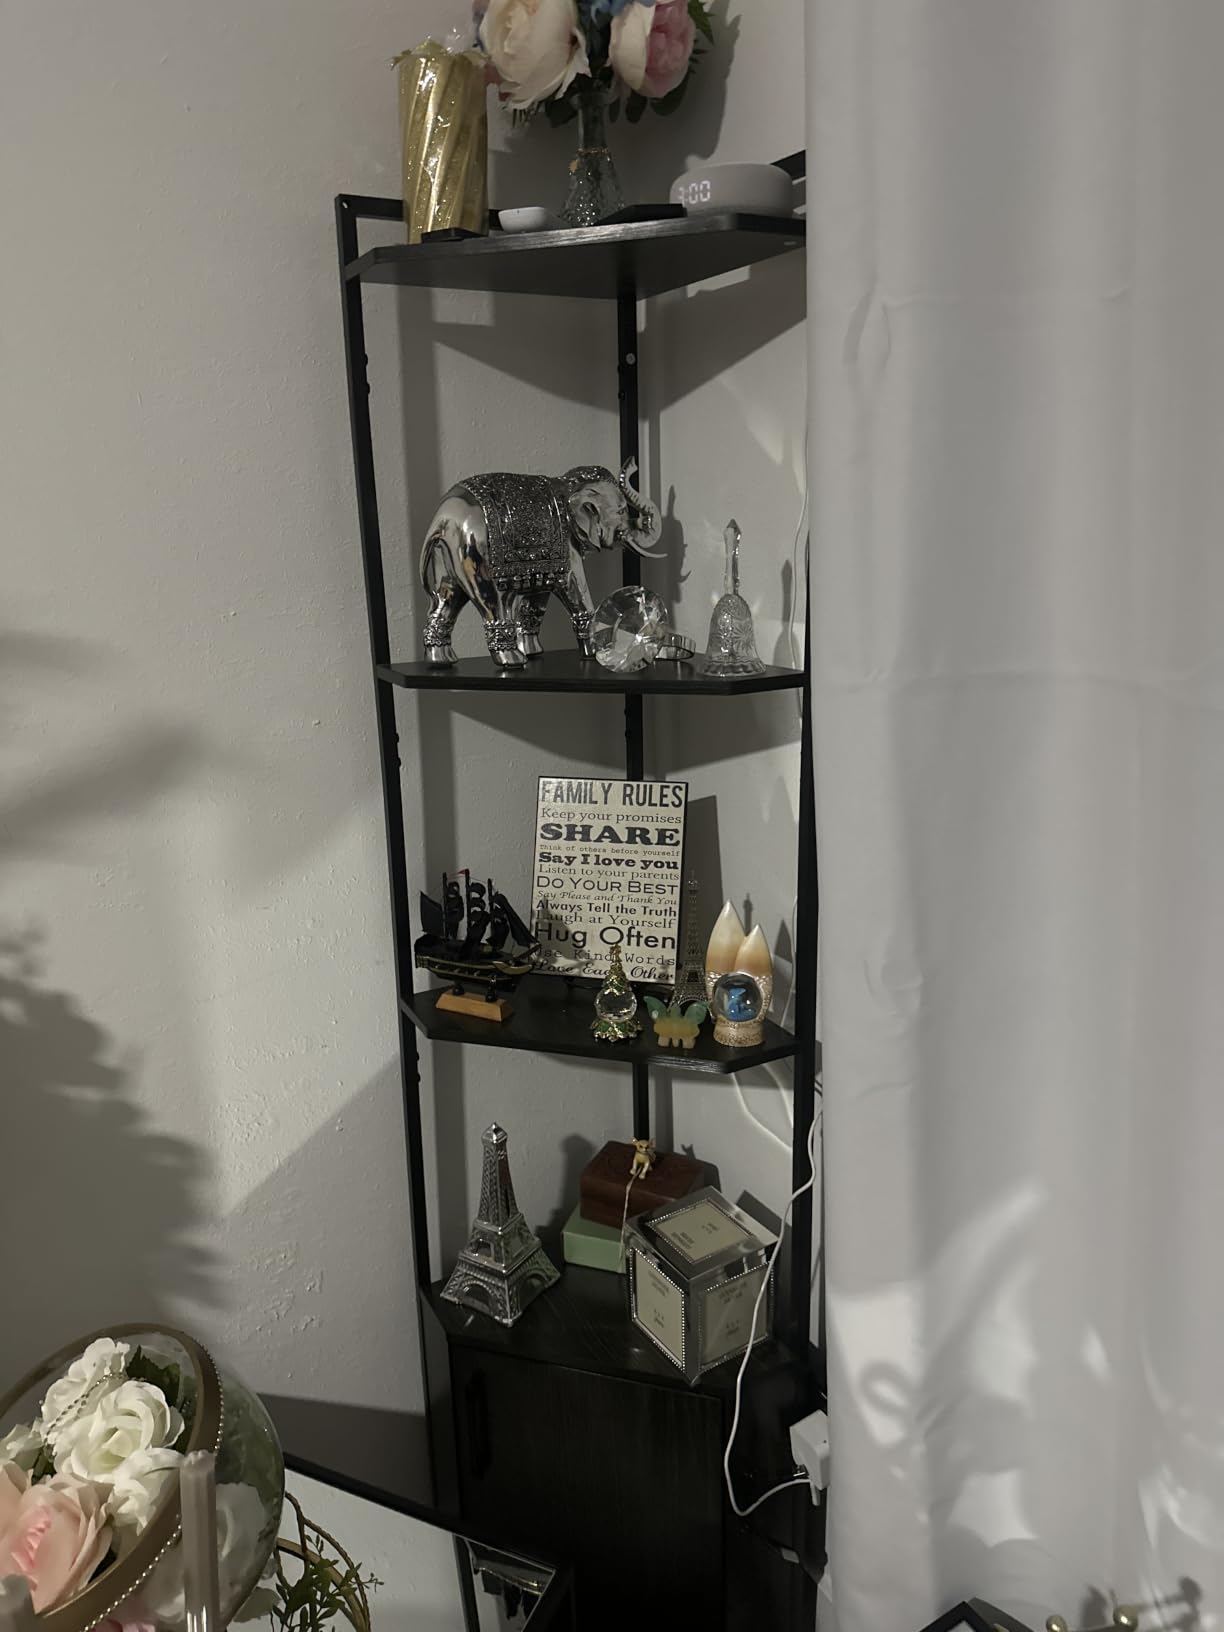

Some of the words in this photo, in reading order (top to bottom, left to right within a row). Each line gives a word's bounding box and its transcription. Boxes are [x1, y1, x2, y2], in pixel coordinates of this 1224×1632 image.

[541, 781, 612, 805] FAMILY
[622, 783, 683, 808] RULES
[541, 808, 575, 821] Keep
[580, 812, 612, 822] your
[616, 814, 682, 824] promises
[539, 822, 680, 846] SHARE
[538, 851, 577, 866] Say
[581, 853, 590, 865] I
[594, 854, 636, 867] love
[640, 859, 679, 870] you
[643, 849, 680, 857] yourself
[538, 864, 577, 875] Listen
[581, 867, 593, 876] to
[597, 869, 628, 878] your
[631, 871, 680, 881] parents
[569, 877, 622, 892] YOUR
[628, 880, 679, 895] BEST
[537, 890, 557, 900] Say
[559, 891, 592, 900] Please
[594, 893, 615, 902] and
[616, 894, 654, 904] Thank
[657, 897, 677, 905] You
[536, 900, 583, 913] Always
[587, 902, 610, 913] Tell
[615, 904, 637, 915] the
[641, 905, 677, 918] Truth
[536, 910, 583, 924] Laugh
[589, 915, 603, 924] at
[608, 914, 677, 929] Yourself
[534, 921, 587, 949] Hug
[599, 926, 676, 950] Often
[625, 952, 676, 966] Words
[582, 962, 613, 975] Eac
[630, 966, 674, 980] Other
